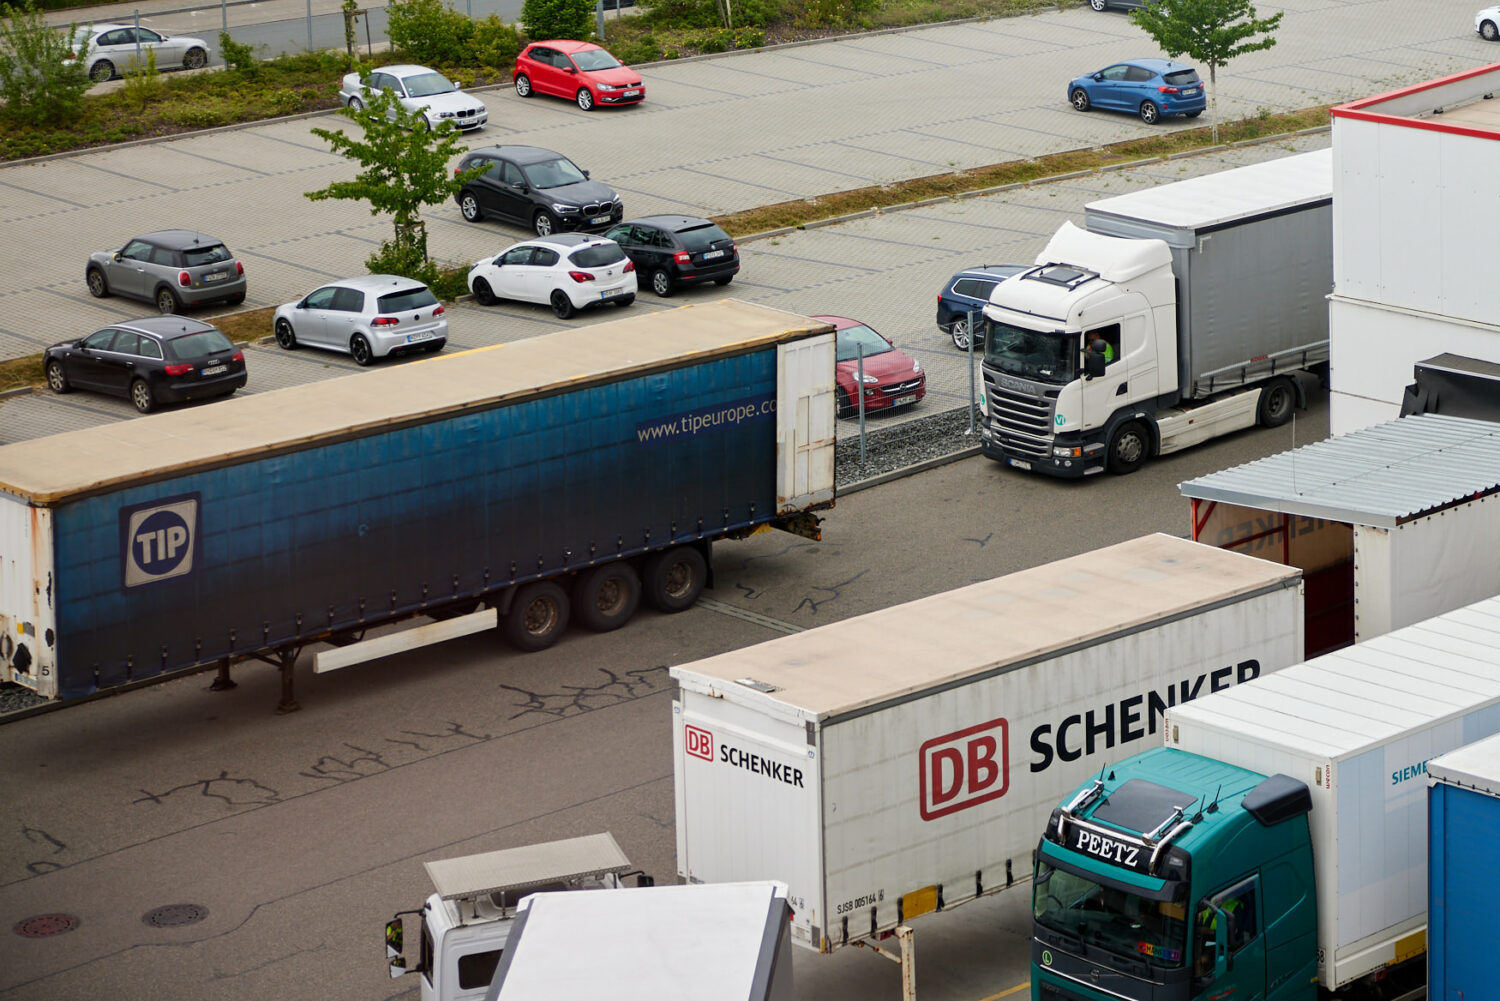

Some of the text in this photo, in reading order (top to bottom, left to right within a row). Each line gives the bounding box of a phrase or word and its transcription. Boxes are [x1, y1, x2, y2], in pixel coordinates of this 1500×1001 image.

[1000, 378, 1036, 394] SCANIA
[136, 525, 187, 565] TIP
[41, 665, 50, 677] 5
[688, 730, 805, 789] DB SCHENKER
[930, 734, 1000, 807] DB
[1392, 759, 1430, 786] SIEME
[1075, 828, 1140, 869] PEETZ
[837, 902, 854, 915] SJSB
[854, 893, 877, 909] 005164
